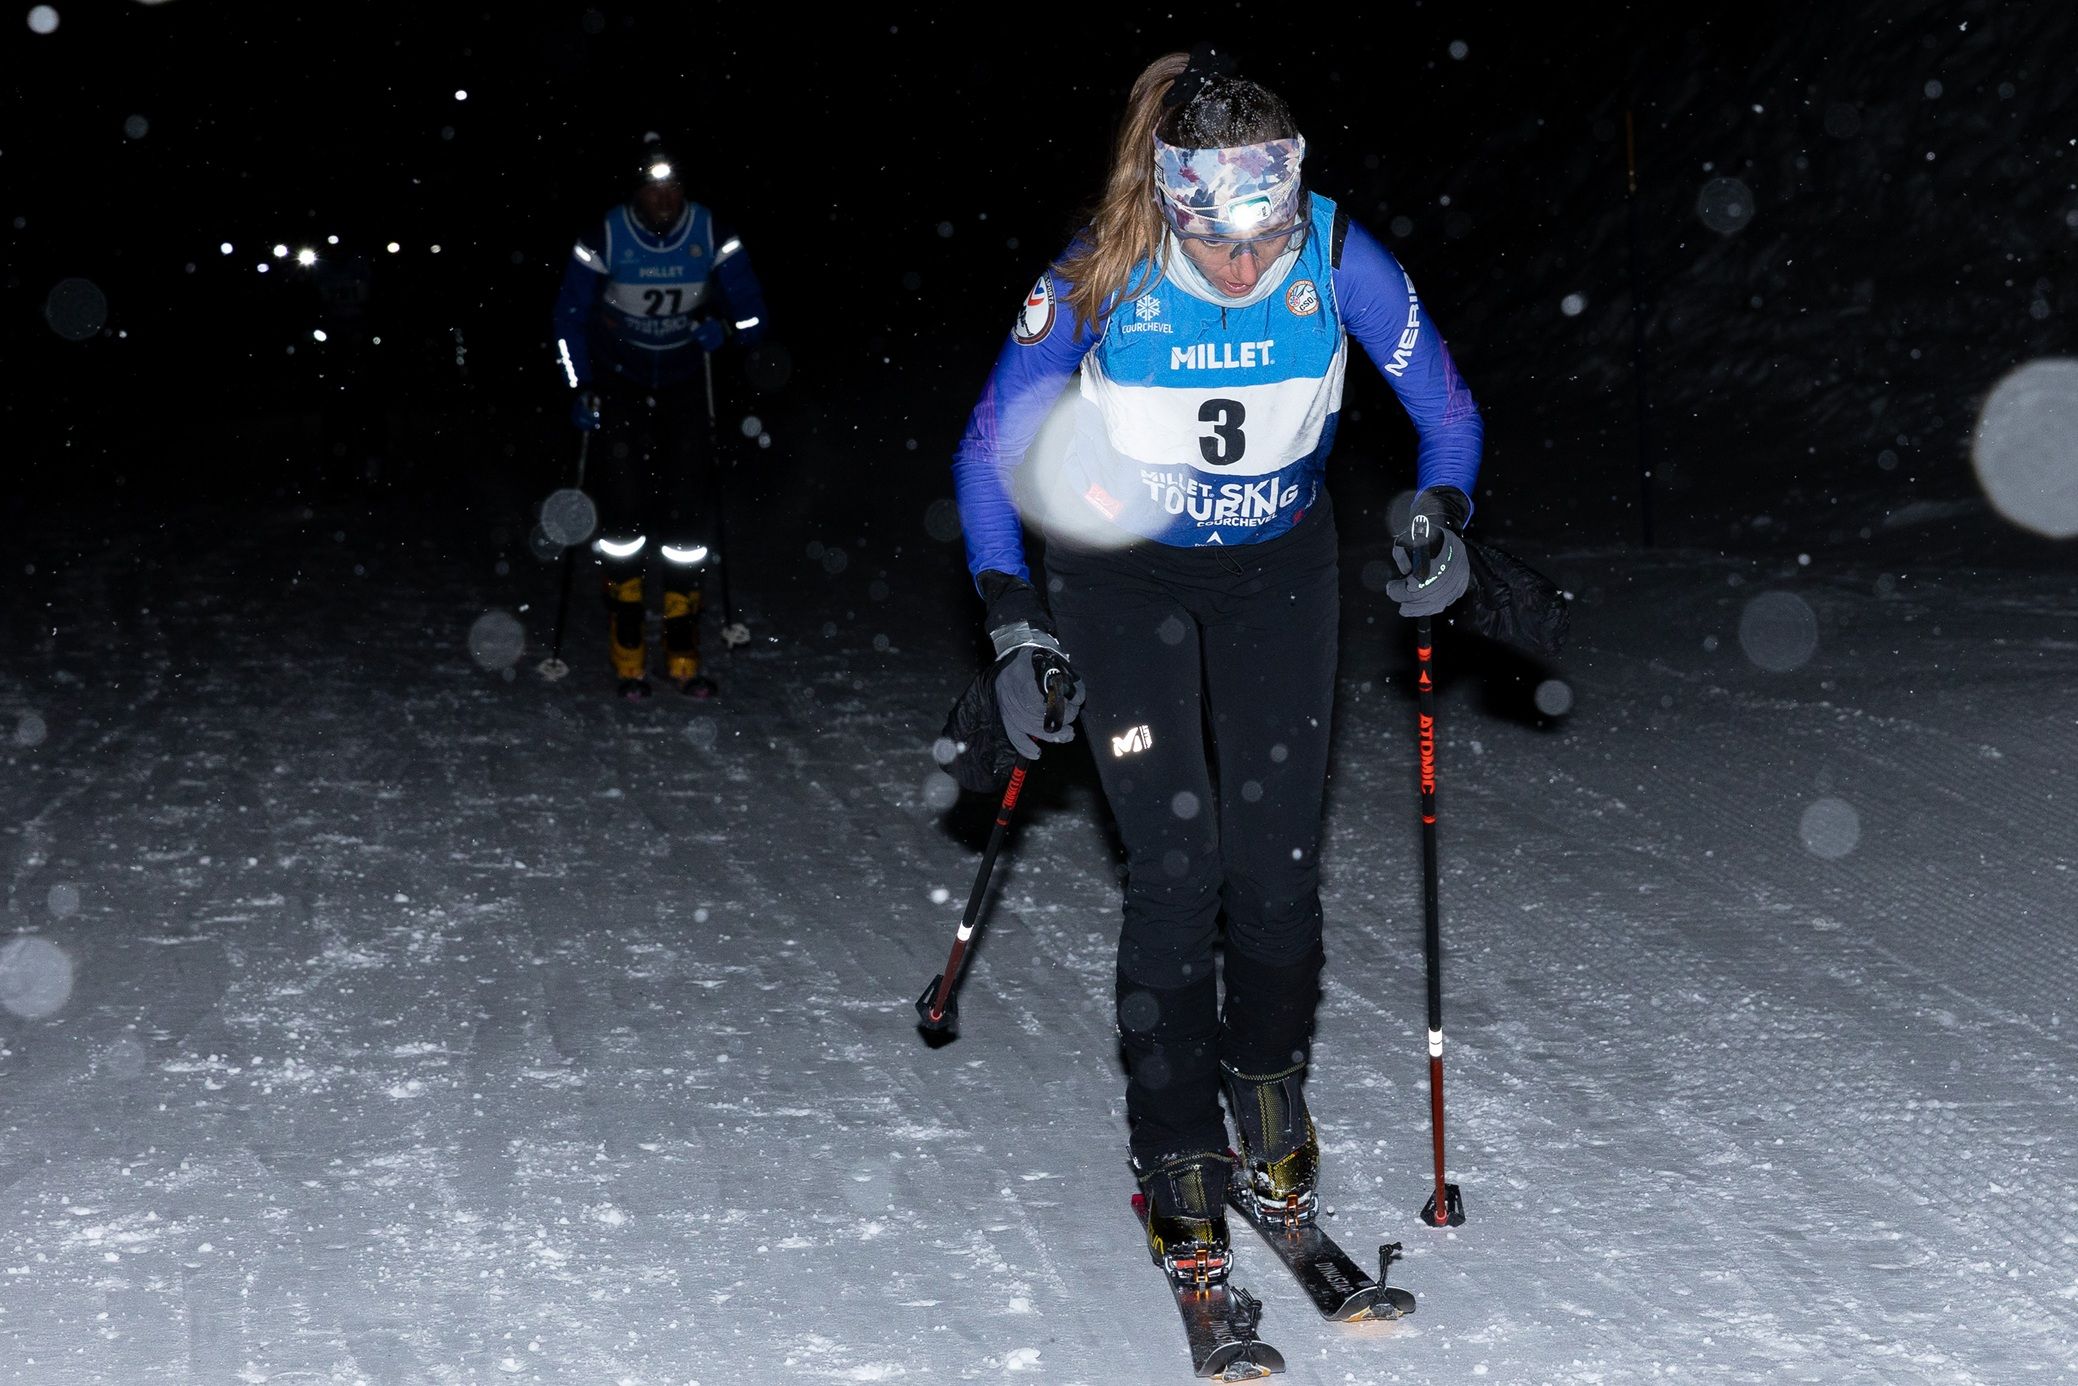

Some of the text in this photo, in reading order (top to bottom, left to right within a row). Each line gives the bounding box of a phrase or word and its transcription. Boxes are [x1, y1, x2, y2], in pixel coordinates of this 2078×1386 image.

[638, 265, 684, 279] MILLET
[643, 288, 683, 317] 27
[1299, 296, 1315, 311] CSO
[1121, 321, 1174, 334] COURCHEVEL
[1170, 339, 1275, 370] MILLET
[1197, 398, 1247, 466] 3
[1140, 469, 1213, 498] MILLET
[1220, 476, 1280, 507] SKI
[1141, 478, 1299, 520] TOURING
[1196, 512, 1278, 527] COURCHEVEL
[1419, 712, 1435, 795] ATOMIC
